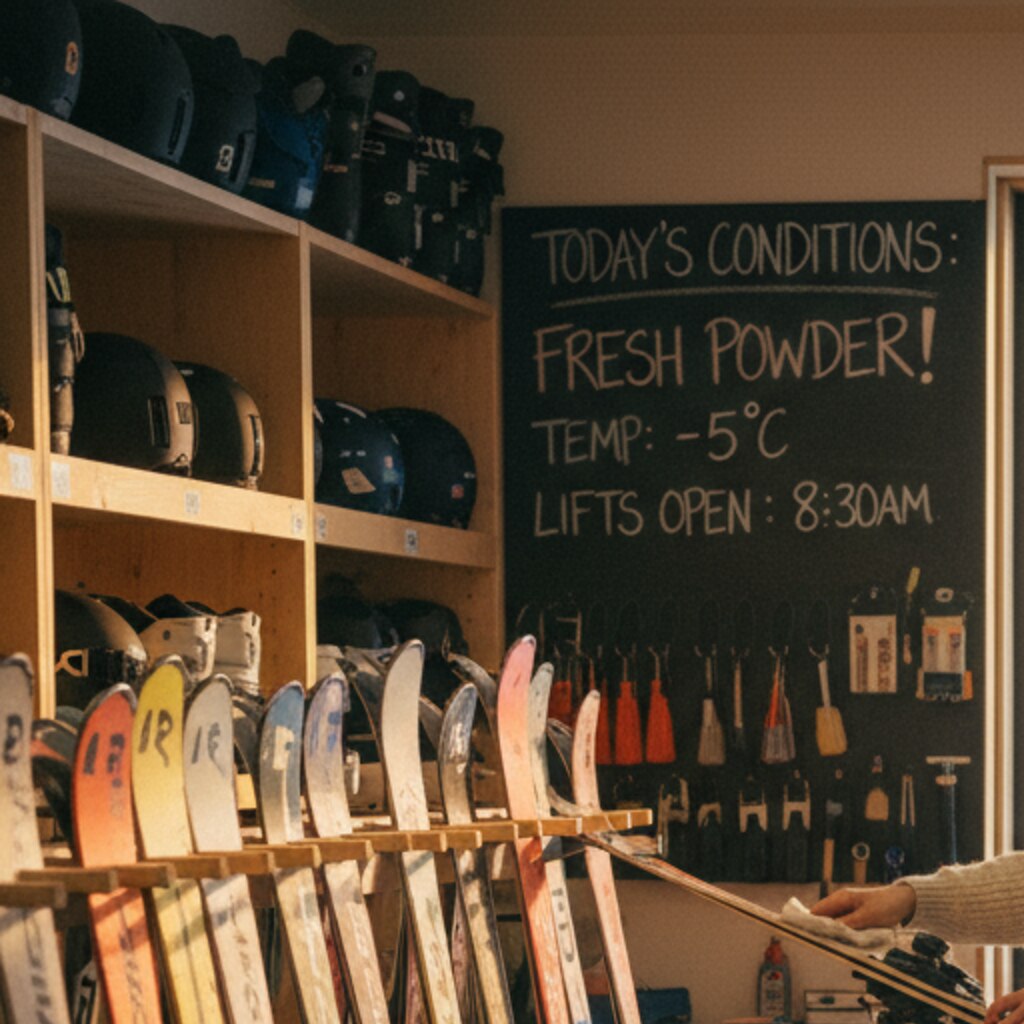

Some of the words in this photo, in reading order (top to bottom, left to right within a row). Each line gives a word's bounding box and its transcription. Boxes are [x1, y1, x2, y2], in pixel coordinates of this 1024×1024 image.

[532, 220, 693, 284] TODAY'S
[708, 221, 958, 276] CONDITIONS:
[534, 324, 684, 392] FRESH
[705, 306, 936, 385] POWDER!
[532, 415, 653, 465] TEMP:
[676, 401, 789, 461] -5°C
[534, 490, 644, 537] LIFTS
[793, 481, 933, 533] 8:30AM
